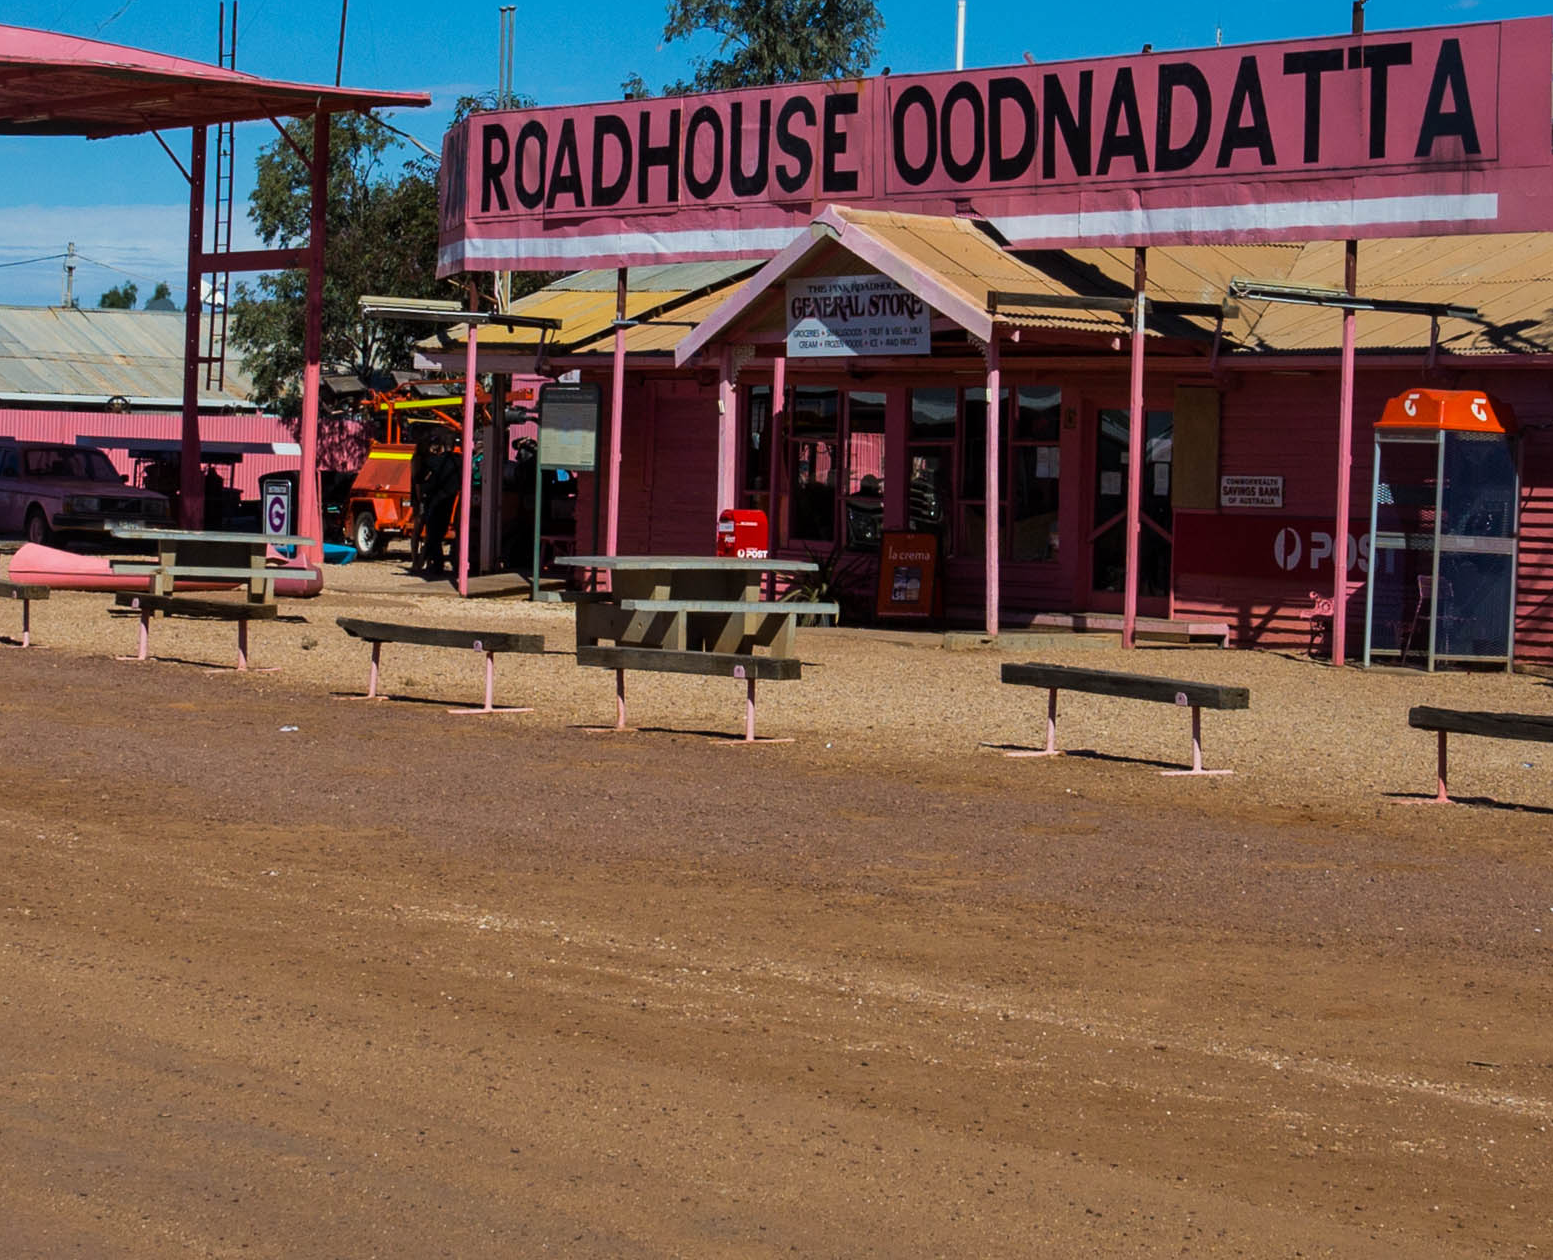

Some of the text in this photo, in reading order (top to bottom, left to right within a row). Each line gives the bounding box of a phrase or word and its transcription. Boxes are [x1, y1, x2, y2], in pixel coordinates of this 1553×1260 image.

[481, 93, 858, 213] ROADHOUSE
[893, 39, 1481, 186] OODNADATTA
[809, 281, 905, 294] THE PINK ROADHOUS
[791, 293, 923, 321] GENERAL STORE
[793, 329, 820, 338] GROCERIES
[799, 340, 818, 349] CREAM
[1226, 477, 1278, 485] COMMONWEALTH
[1222, 486, 1280, 496] SAVINGS BANK
[746, 550, 768, 559] POST
